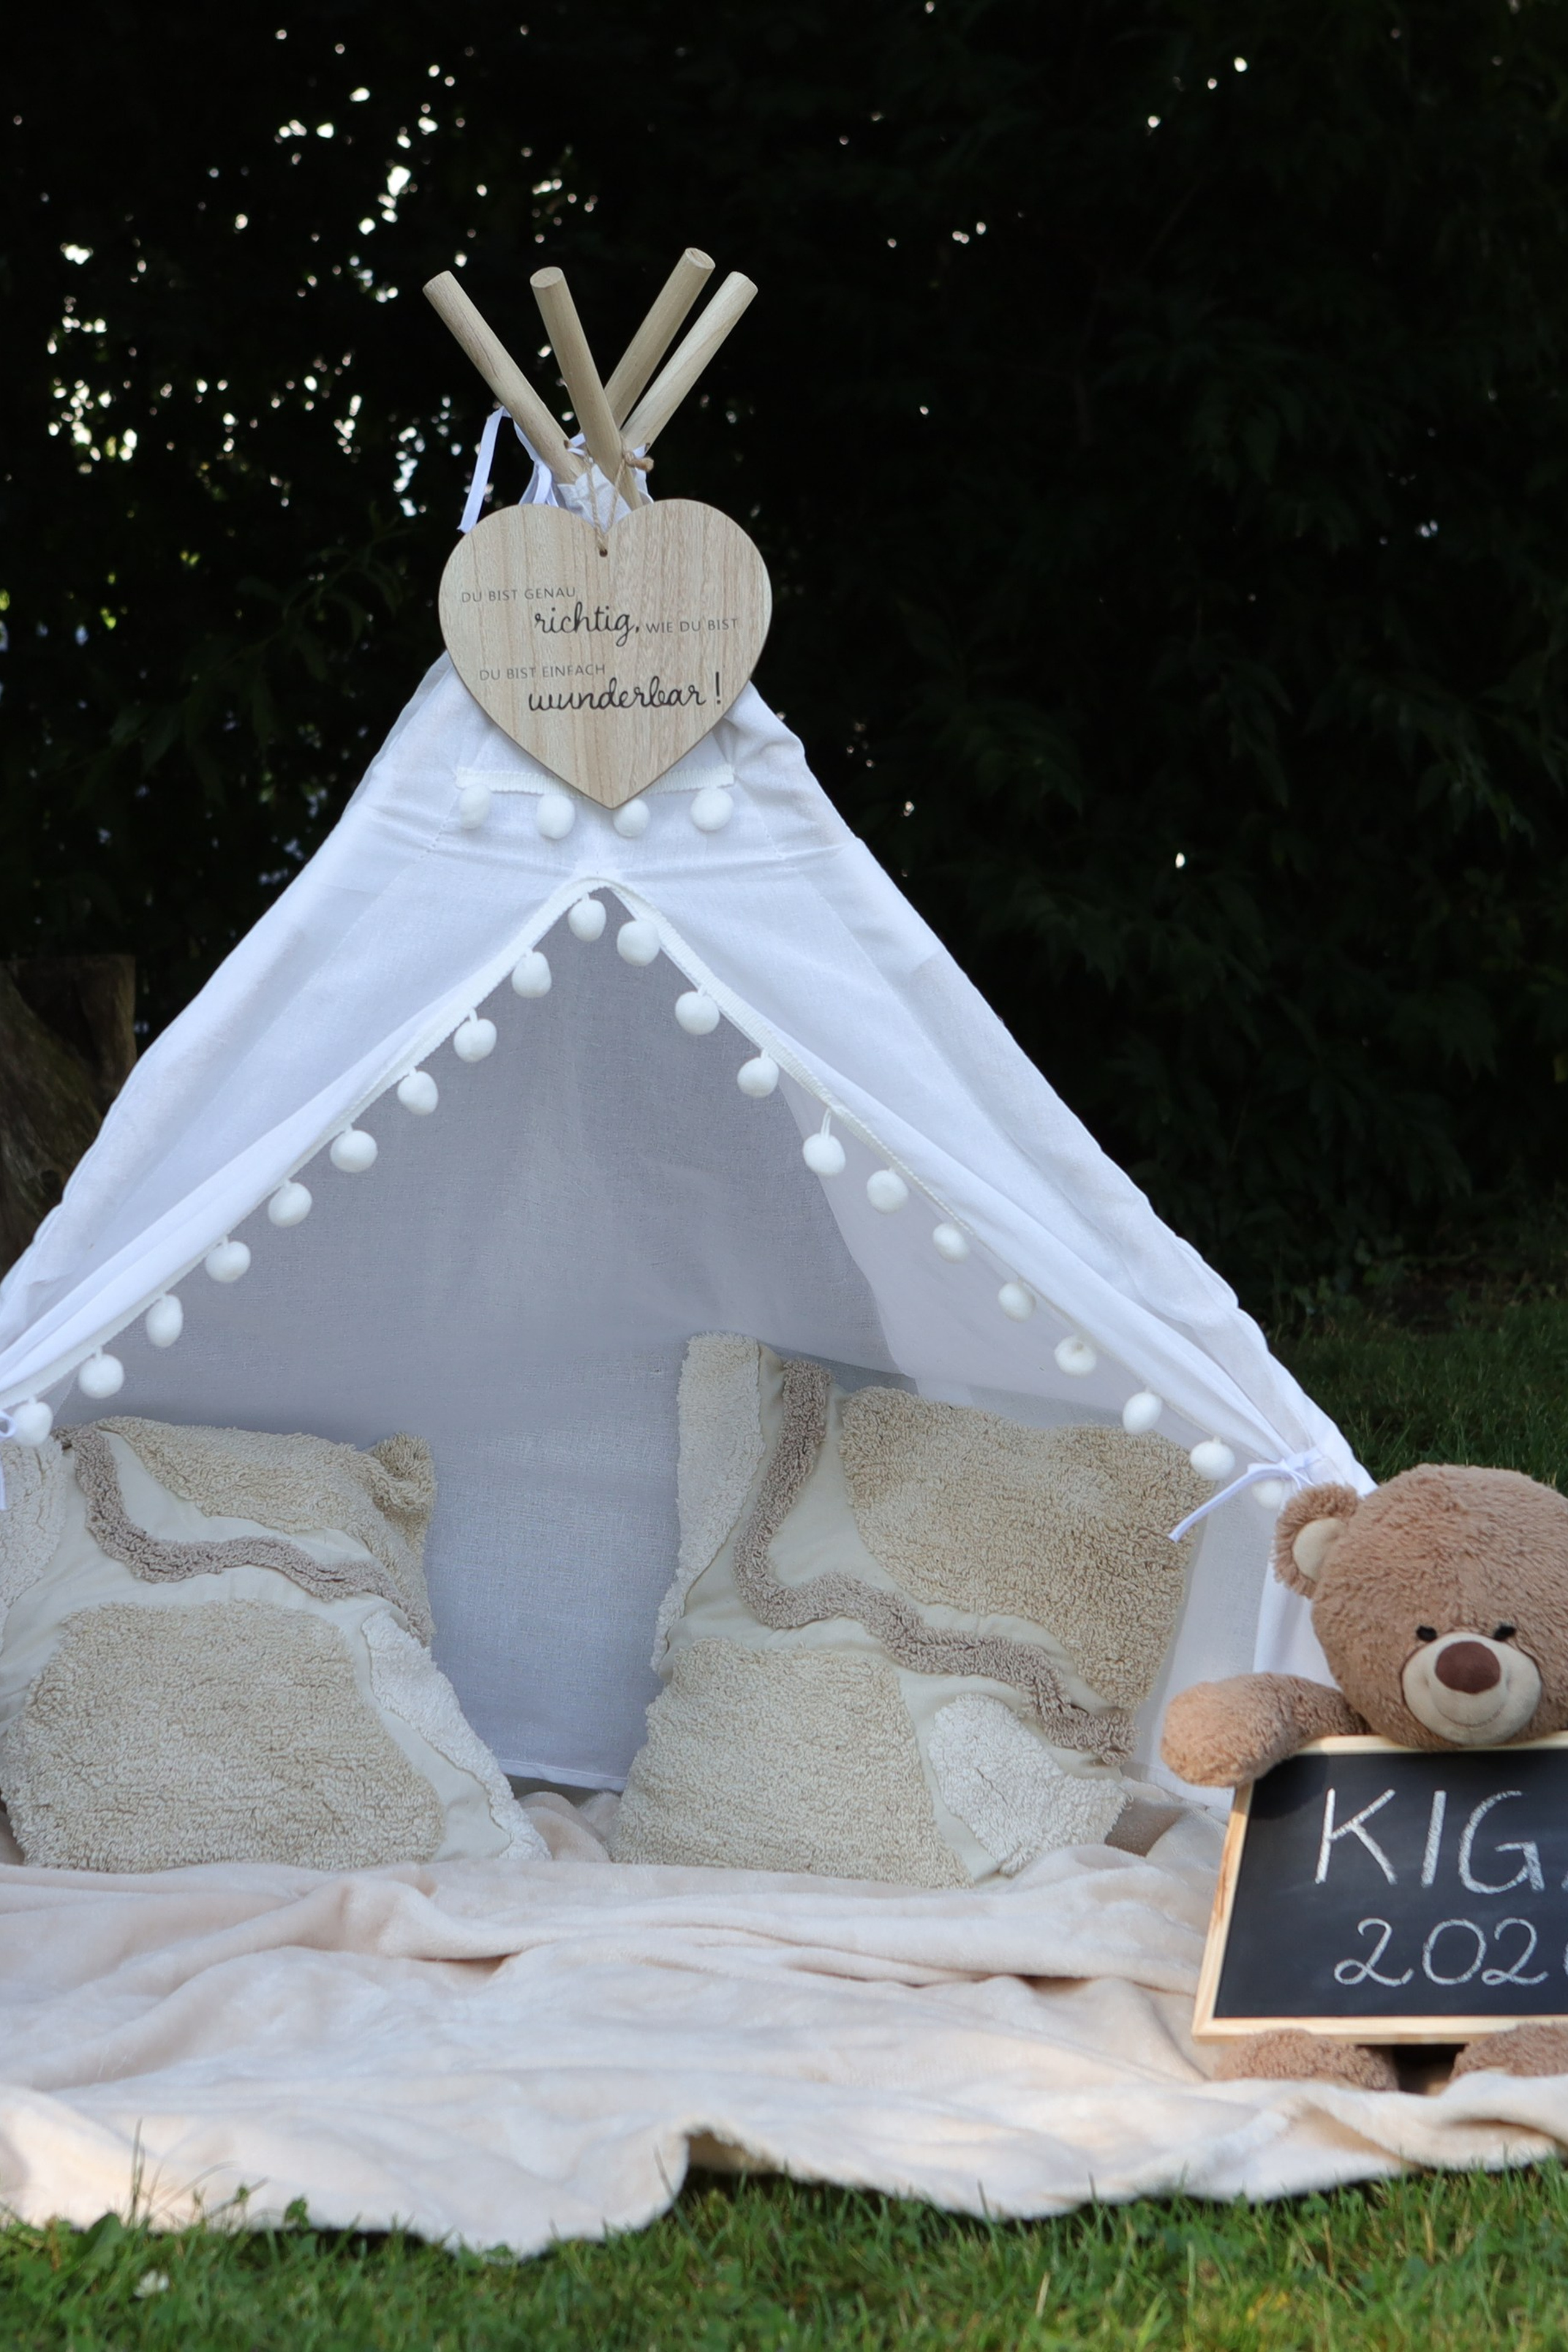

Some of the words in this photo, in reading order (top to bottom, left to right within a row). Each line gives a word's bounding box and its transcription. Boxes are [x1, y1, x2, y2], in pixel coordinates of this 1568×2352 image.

[461, 590, 483, 603] DU
[488, 589, 518, 602] BIST
[524, 587, 576, 600] GENAU
[534, 601, 641, 647] richtig,
[646, 621, 674, 635] WIE
[679, 619, 701, 633] DU
[707, 617, 738, 631] BIST
[479, 669, 501, 682] DU
[506, 666, 537, 680] BIST
[541, 664, 606, 678] EINFACH
[1315, 1787, 1568, 1894] KIG
[1333, 1917, 1568, 1987] 202
